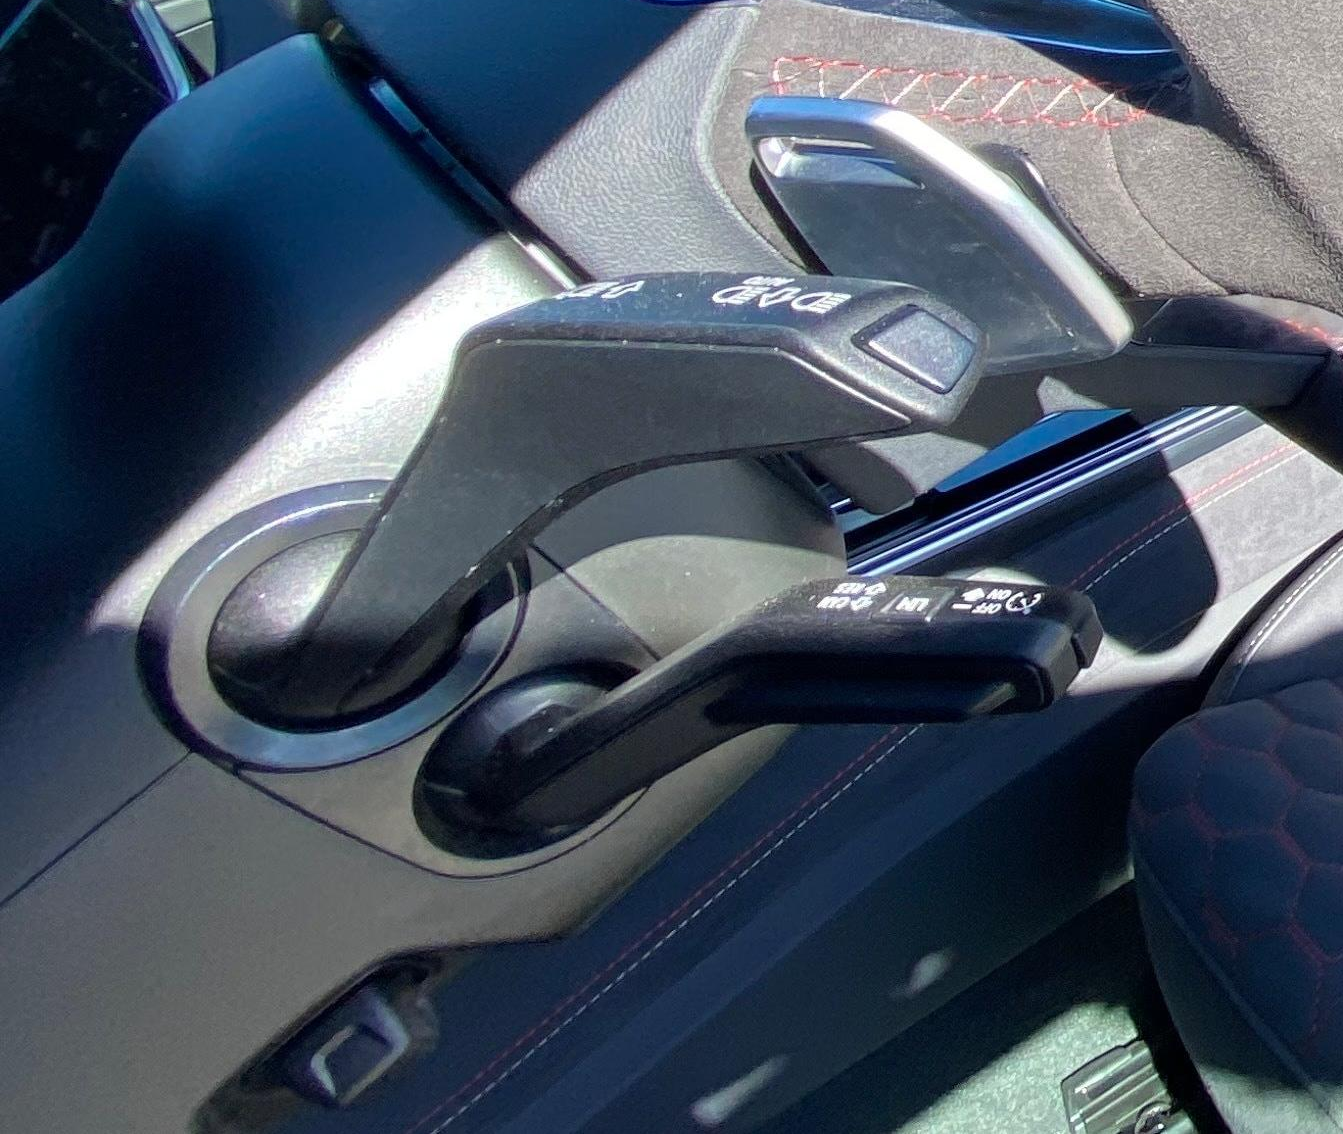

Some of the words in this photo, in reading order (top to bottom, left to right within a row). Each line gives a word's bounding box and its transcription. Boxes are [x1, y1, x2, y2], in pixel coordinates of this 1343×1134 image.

[985, 588, 1012, 601] ON
[895, 596, 930, 612] LIM
[971, 603, 1002, 614] OFF
